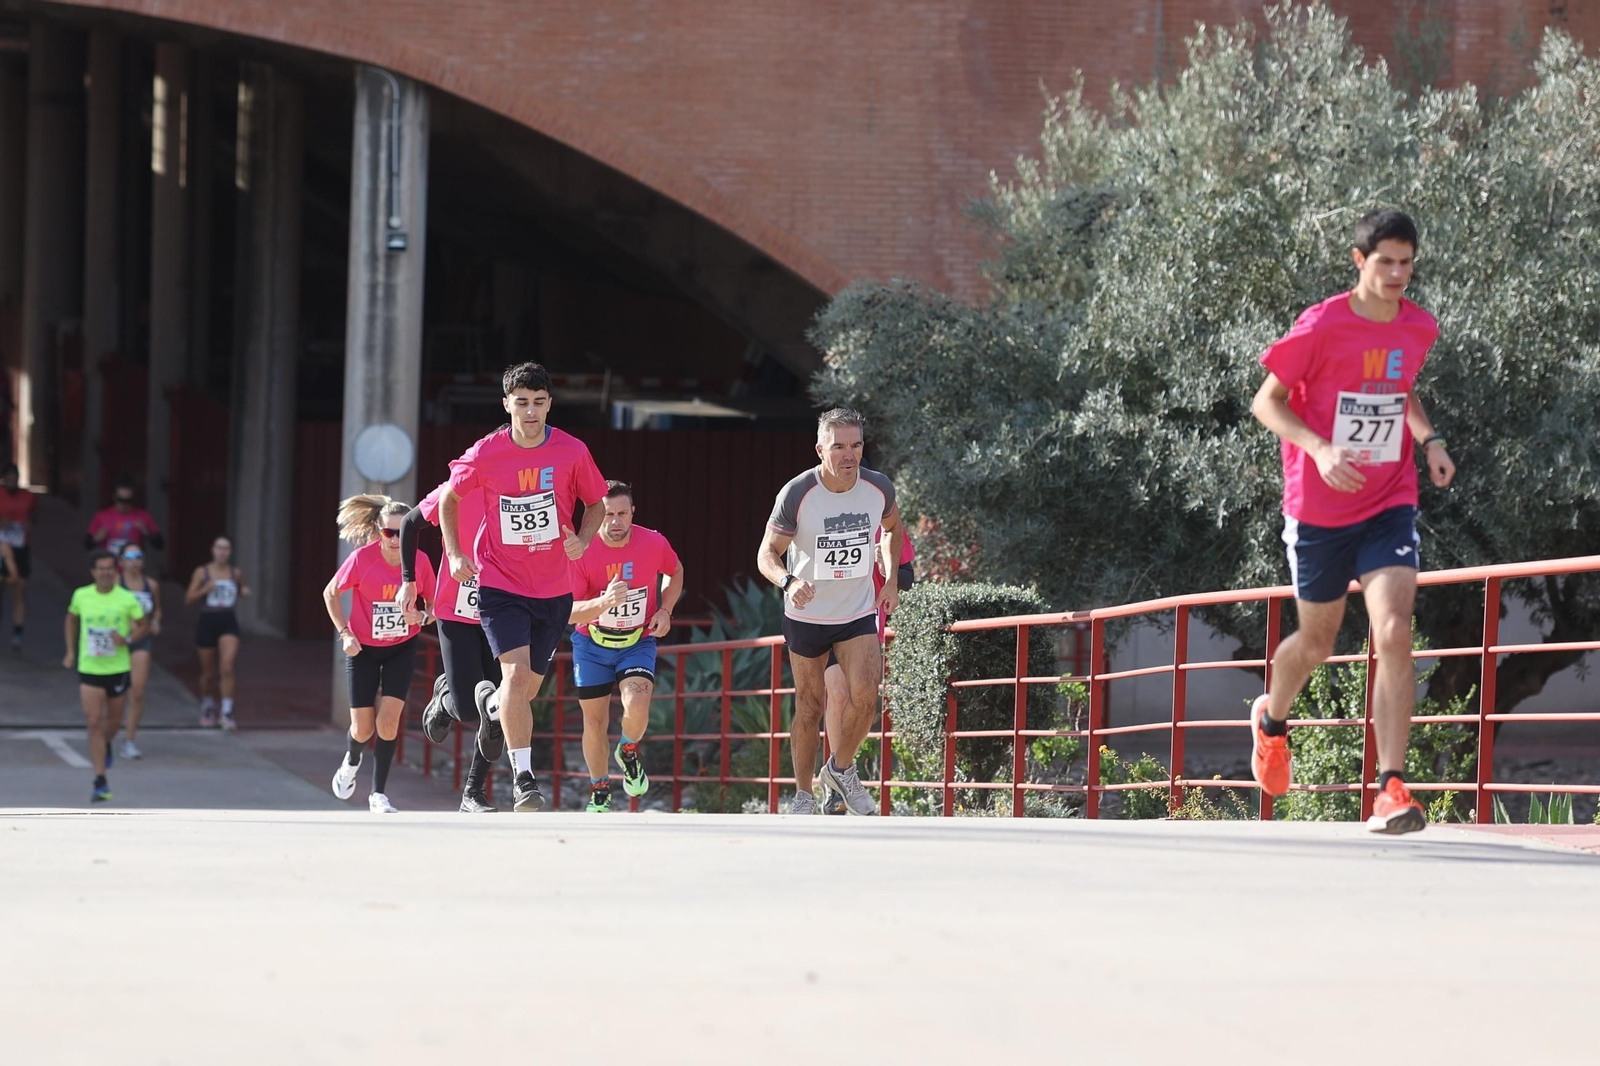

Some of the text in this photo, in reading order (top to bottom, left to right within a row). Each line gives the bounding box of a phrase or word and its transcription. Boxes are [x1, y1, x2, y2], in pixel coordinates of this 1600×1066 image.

[1362, 348, 1404, 379] WE
[1341, 404, 1375, 415] UMA
[1348, 419, 1395, 442] 277
[517, 466, 554, 491] WE
[502, 504, 527, 512] UMA
[510, 510, 550, 531] 583
[824, 547, 862, 566] 429
[606, 561, 634, 581] WE
[382, 584, 401, 600] W
[608, 601, 640, 617] 415
[374, 615, 406, 630] 454
